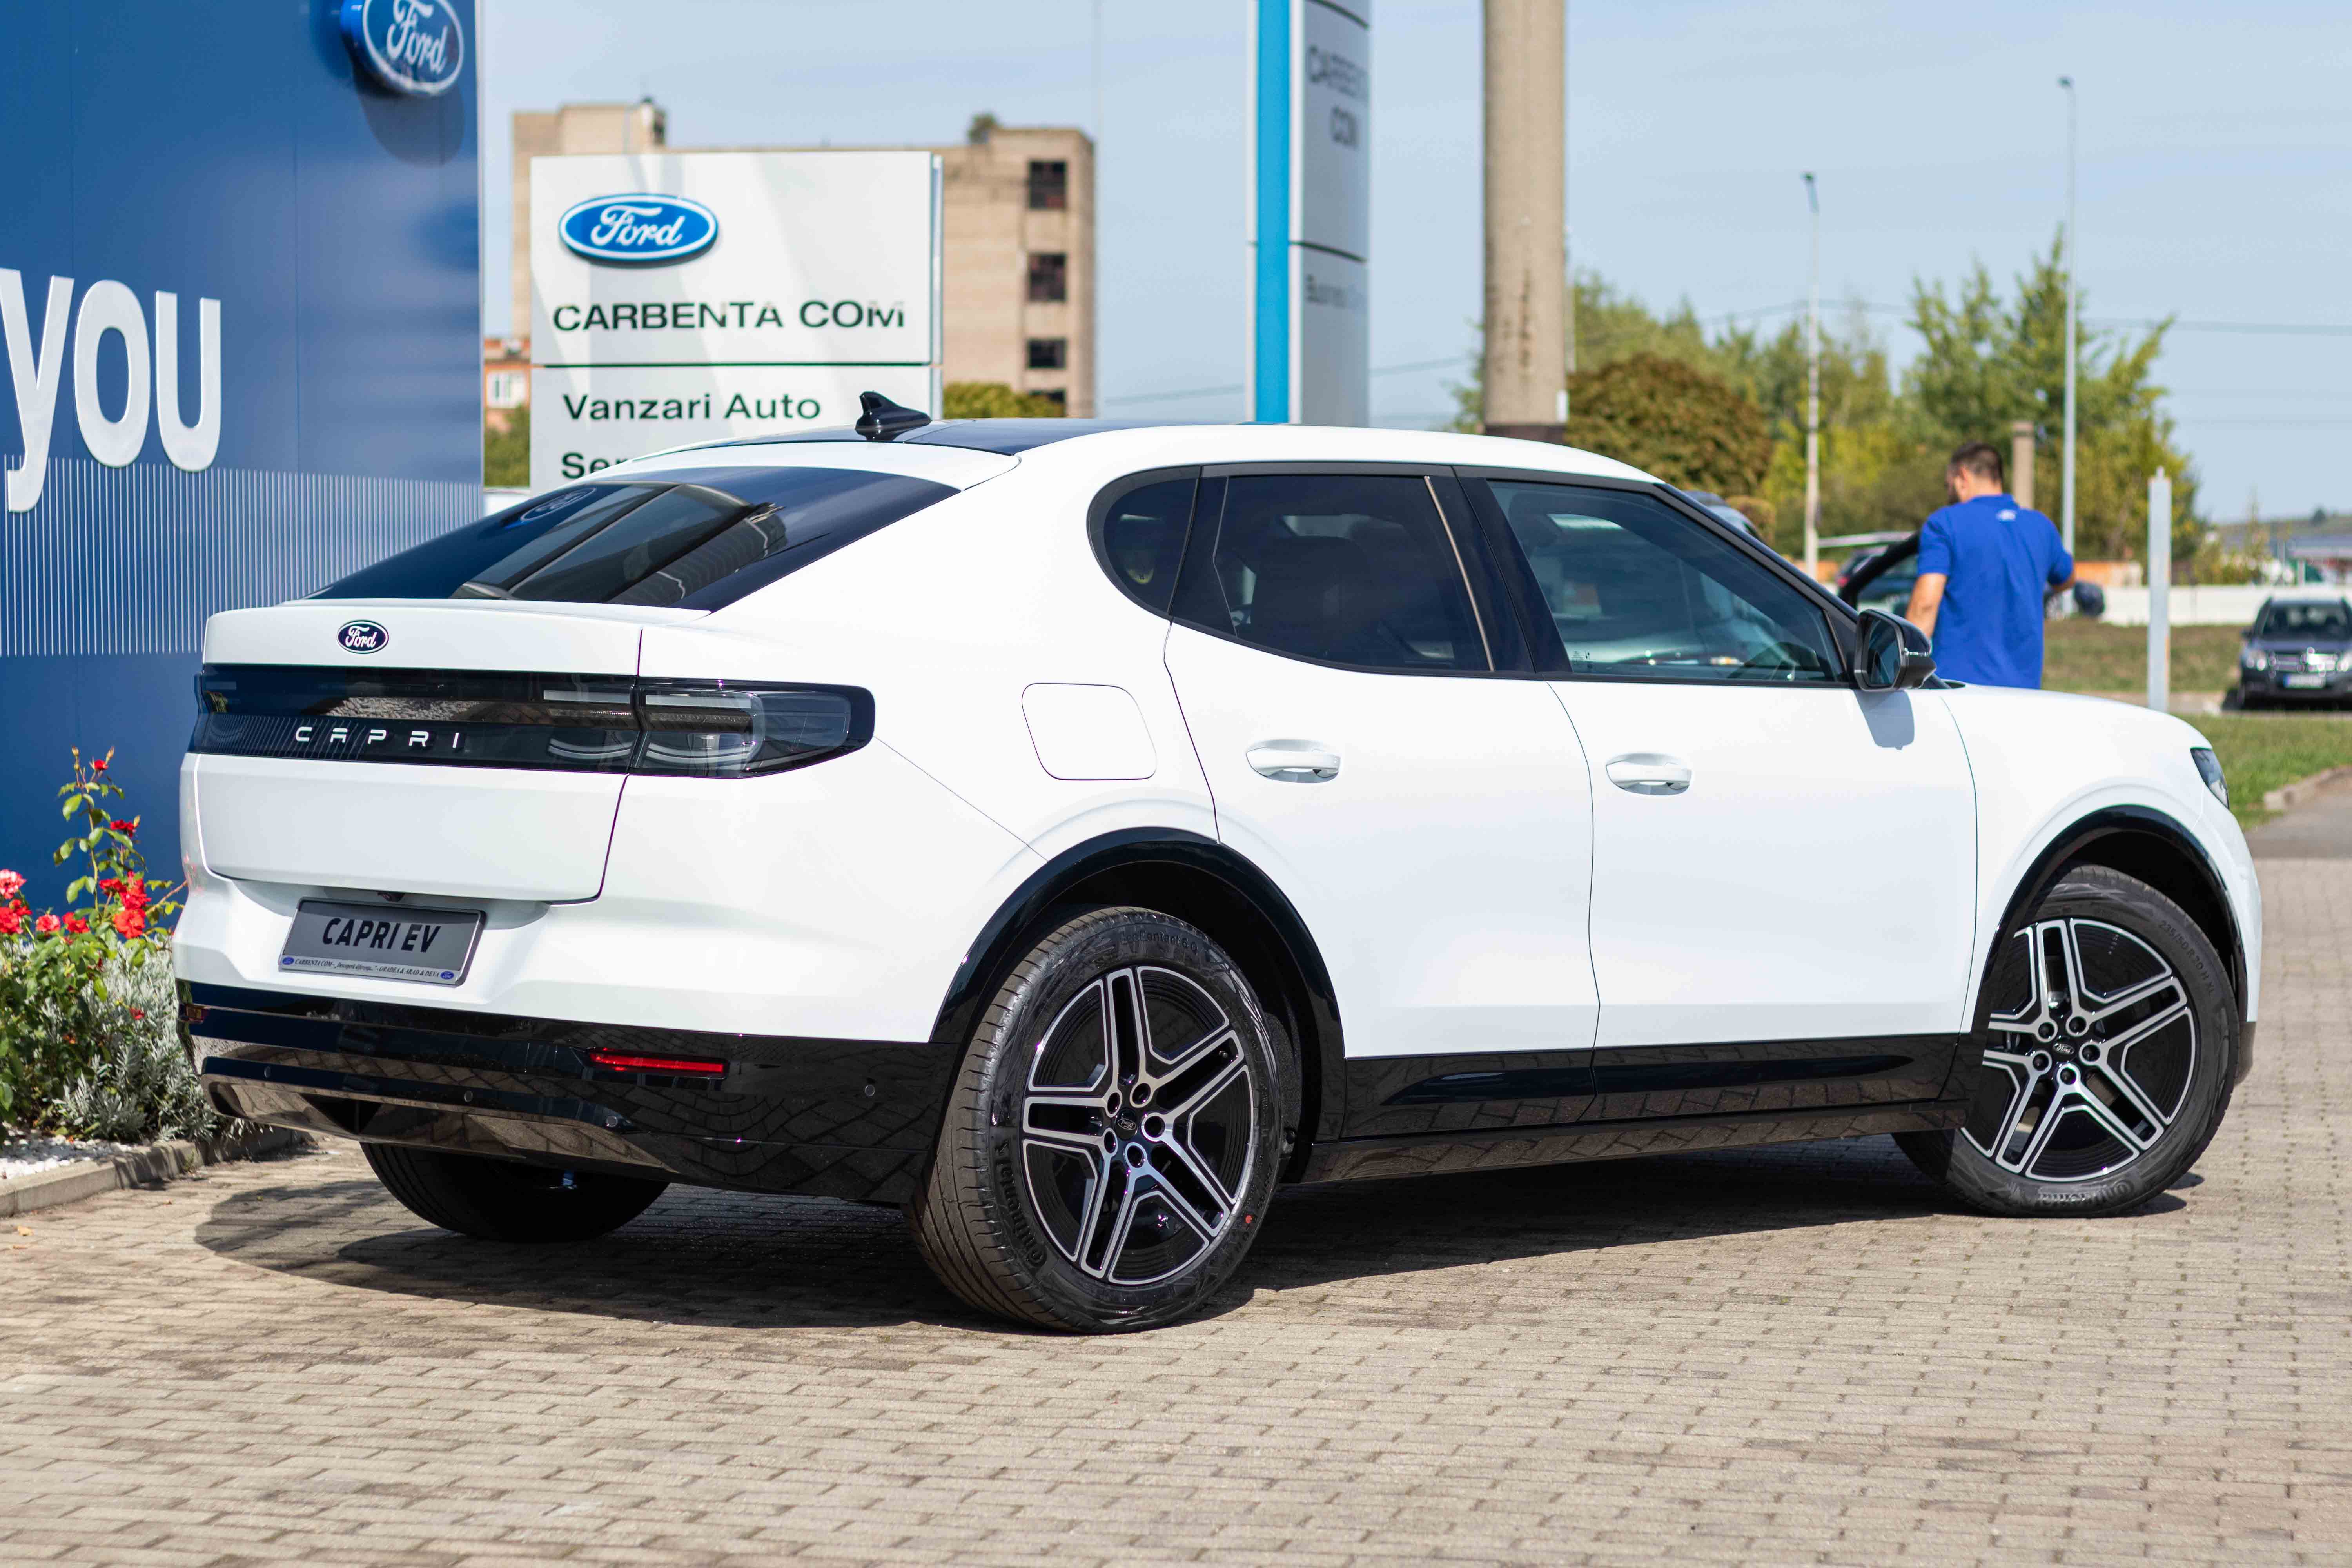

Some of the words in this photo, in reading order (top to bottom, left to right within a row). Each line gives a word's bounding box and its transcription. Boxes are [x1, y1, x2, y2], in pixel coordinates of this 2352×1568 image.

[386, 0, 447, 74] Ford
[590, 205, 685, 246] Ford
[554, 302, 784, 331] CARBENTA
[799, 300, 905, 328] COM
[0, 267, 221, 513] you
[563, 393, 710, 419] Vanzari
[724, 392, 820, 419] Auto
[345, 625, 377, 648] Ford
[296, 726, 460, 748] CAPRI
[322, 918, 401, 949] CAPRI
[401, 924, 442, 953] EV
